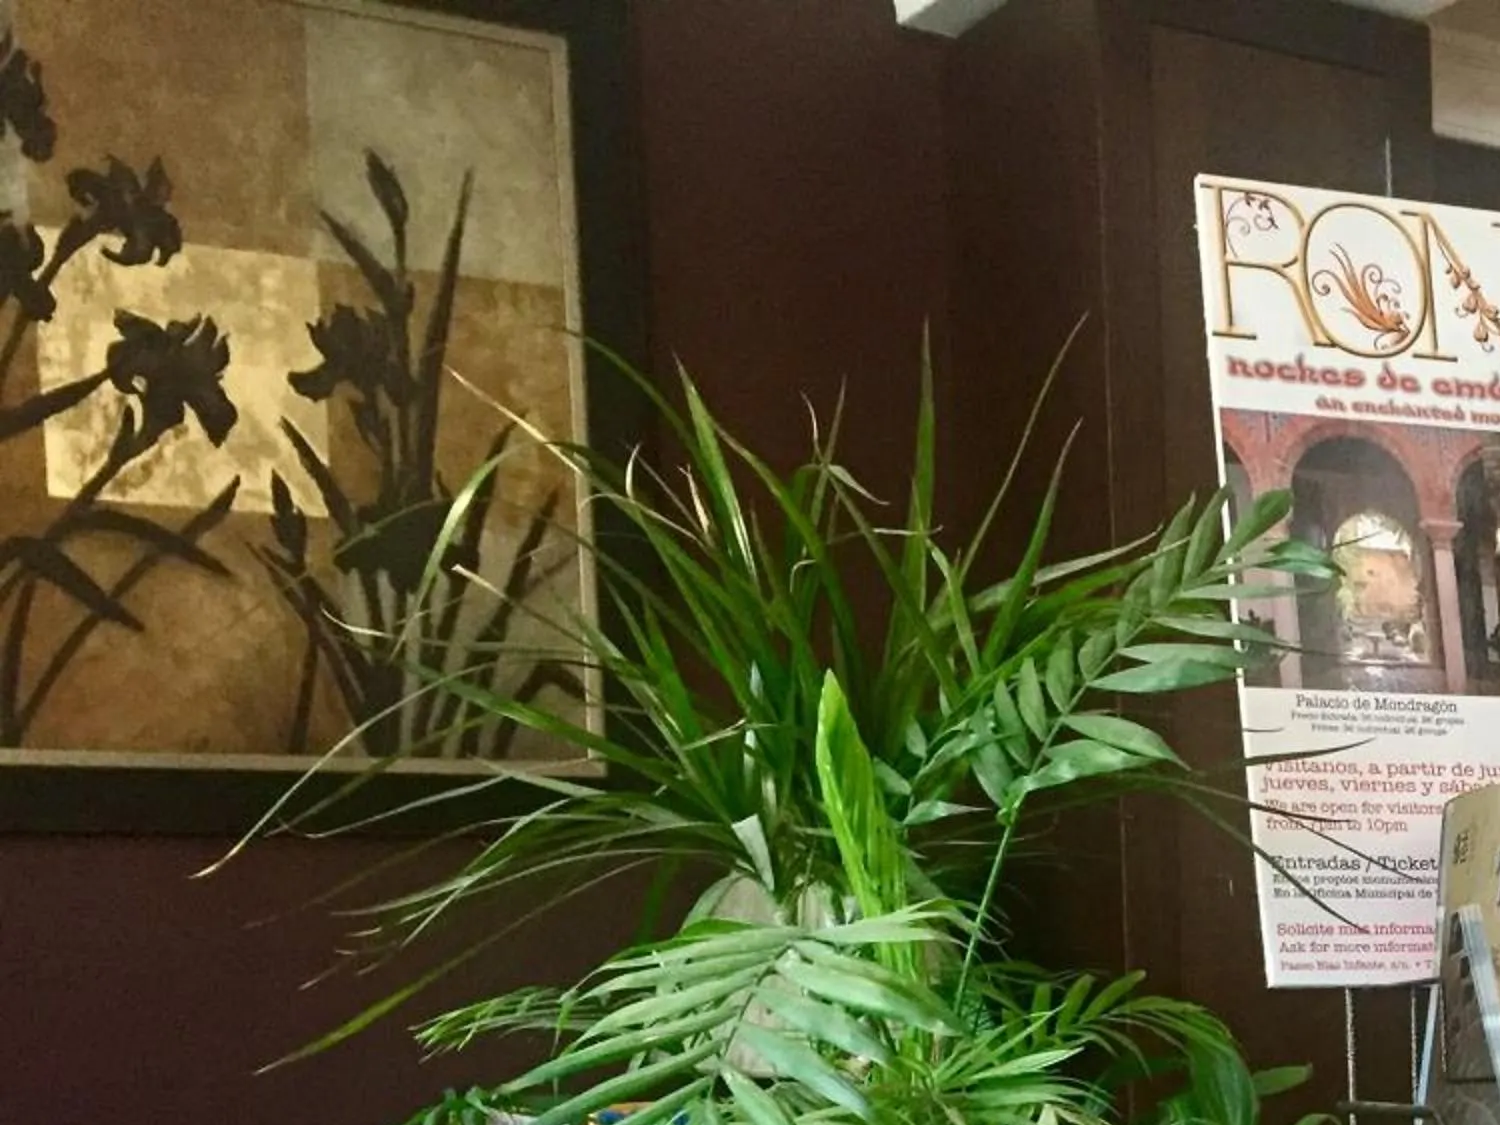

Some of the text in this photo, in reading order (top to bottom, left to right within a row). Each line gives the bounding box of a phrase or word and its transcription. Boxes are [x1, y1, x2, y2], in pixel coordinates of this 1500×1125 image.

[1226, 352, 1366, 388] noches
[1377, 361, 1421, 393] de
[1316, 394, 1346, 413] an
[1351, 399, 1466, 422] enchanted
[1295, 693, 1350, 710] Palacio
[1353, 696, 1371, 711] de
[1368, 762, 1380, 775] a
[1387, 761, 1446, 778] partir
[1451, 761, 1474, 777] de
[1260, 777, 1335, 794] jueves,
[1340, 777, 1416, 793] viernes
[1421, 781, 1434, 796] y
[1291, 801, 1317, 813] are
[1321, 802, 1357, 817] open
[1361, 800, 1384, 814] for
[1386, 801, 1443, 816] visitors
[1368, 818, 1408, 834] 10pm
[1270, 855, 1361, 871] Entradas
[1354, 887, 1415, 901] Municipal
[1417, 888, 1433, 899] de
[1277, 922, 1335, 936] Solicite
[1279, 940, 1307, 954] Ask
[1310, 940, 1330, 953] for
[1333, 941, 1371, 954] more
